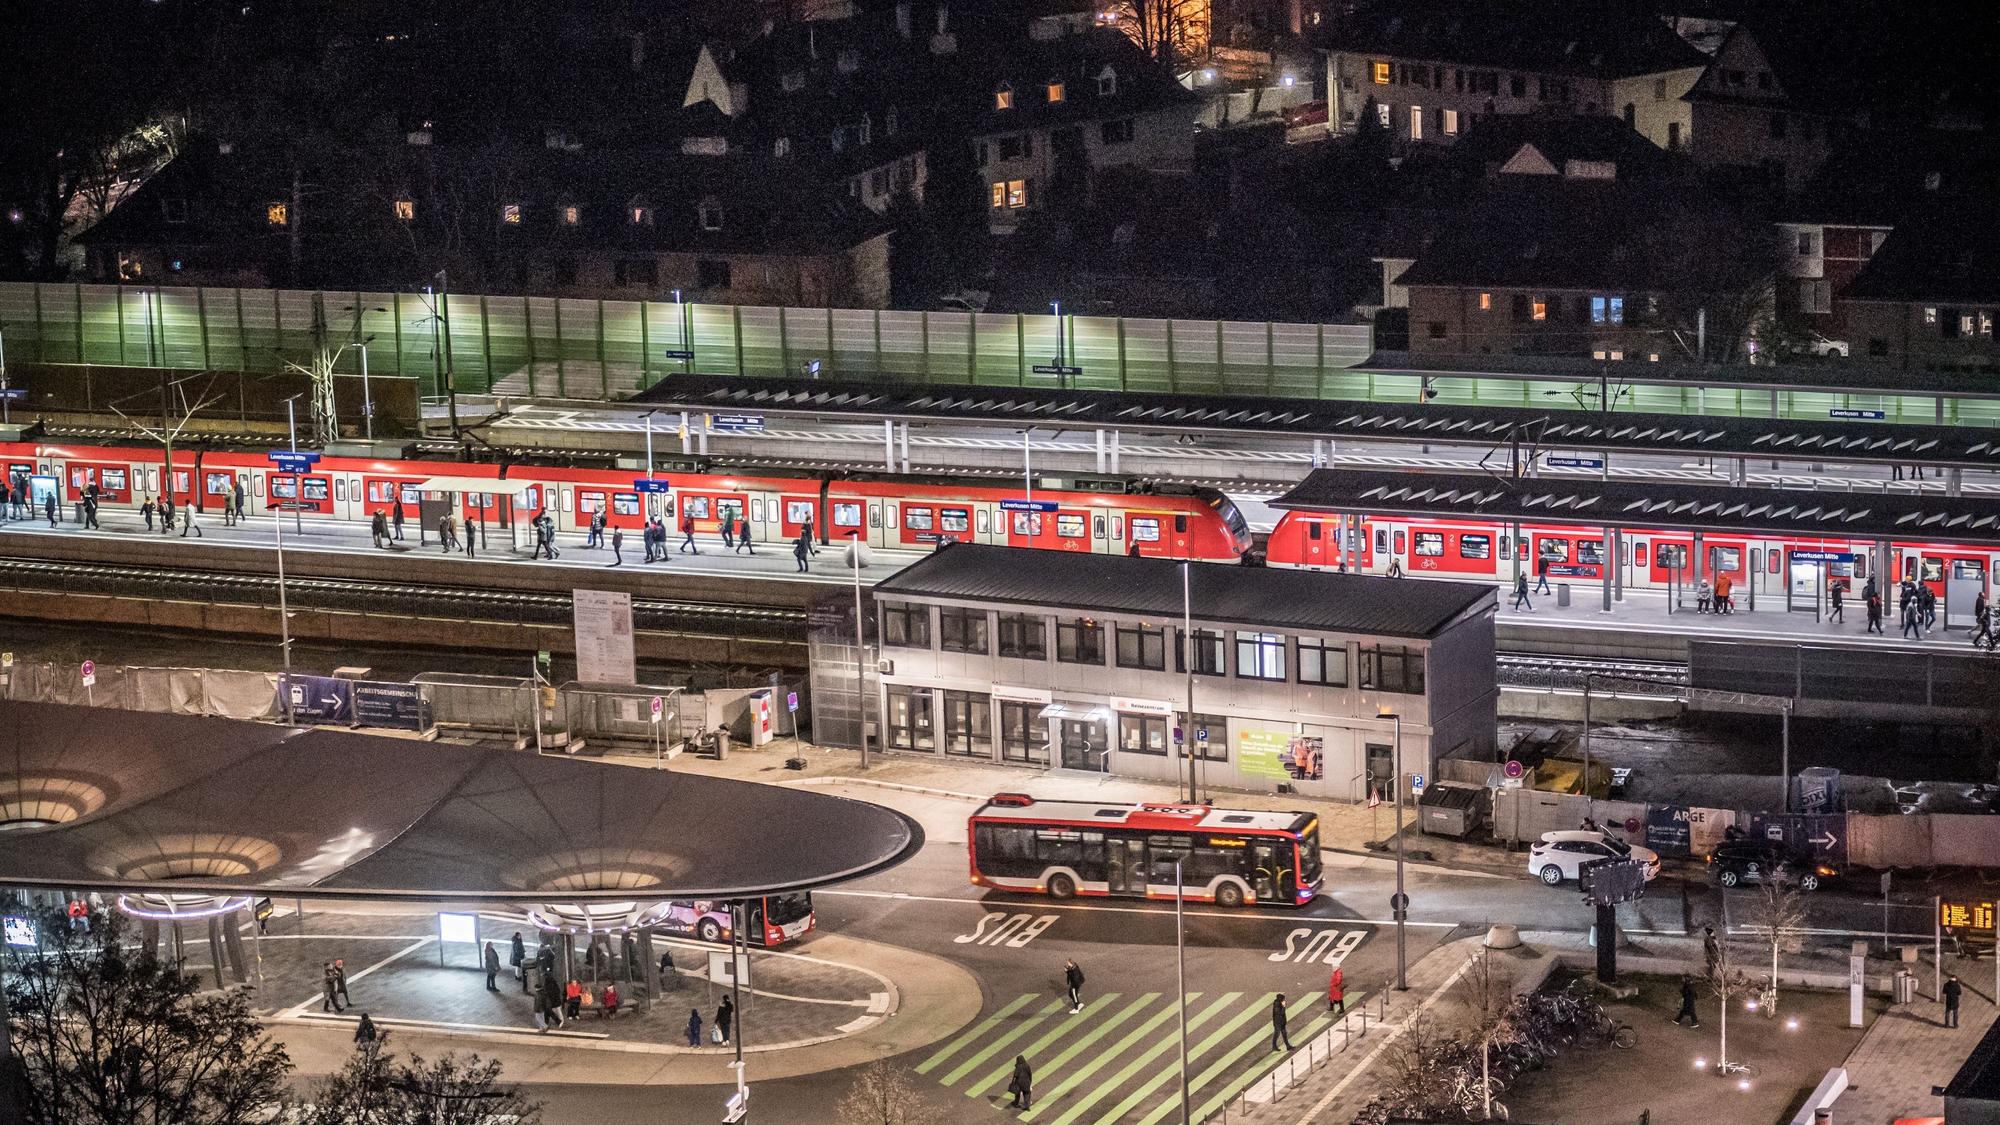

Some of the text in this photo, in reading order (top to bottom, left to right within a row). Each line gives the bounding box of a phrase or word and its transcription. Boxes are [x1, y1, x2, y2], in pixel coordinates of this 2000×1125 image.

[1793, 551, 1824, 559] Leverkusen
[1199, 730, 1206, 740] P
[1414, 775, 1422, 788] P
[1672, 810, 1705, 823] ARGE
[953, 912, 1060, 947] BUS
[1268, 928, 1368, 964] BUS
